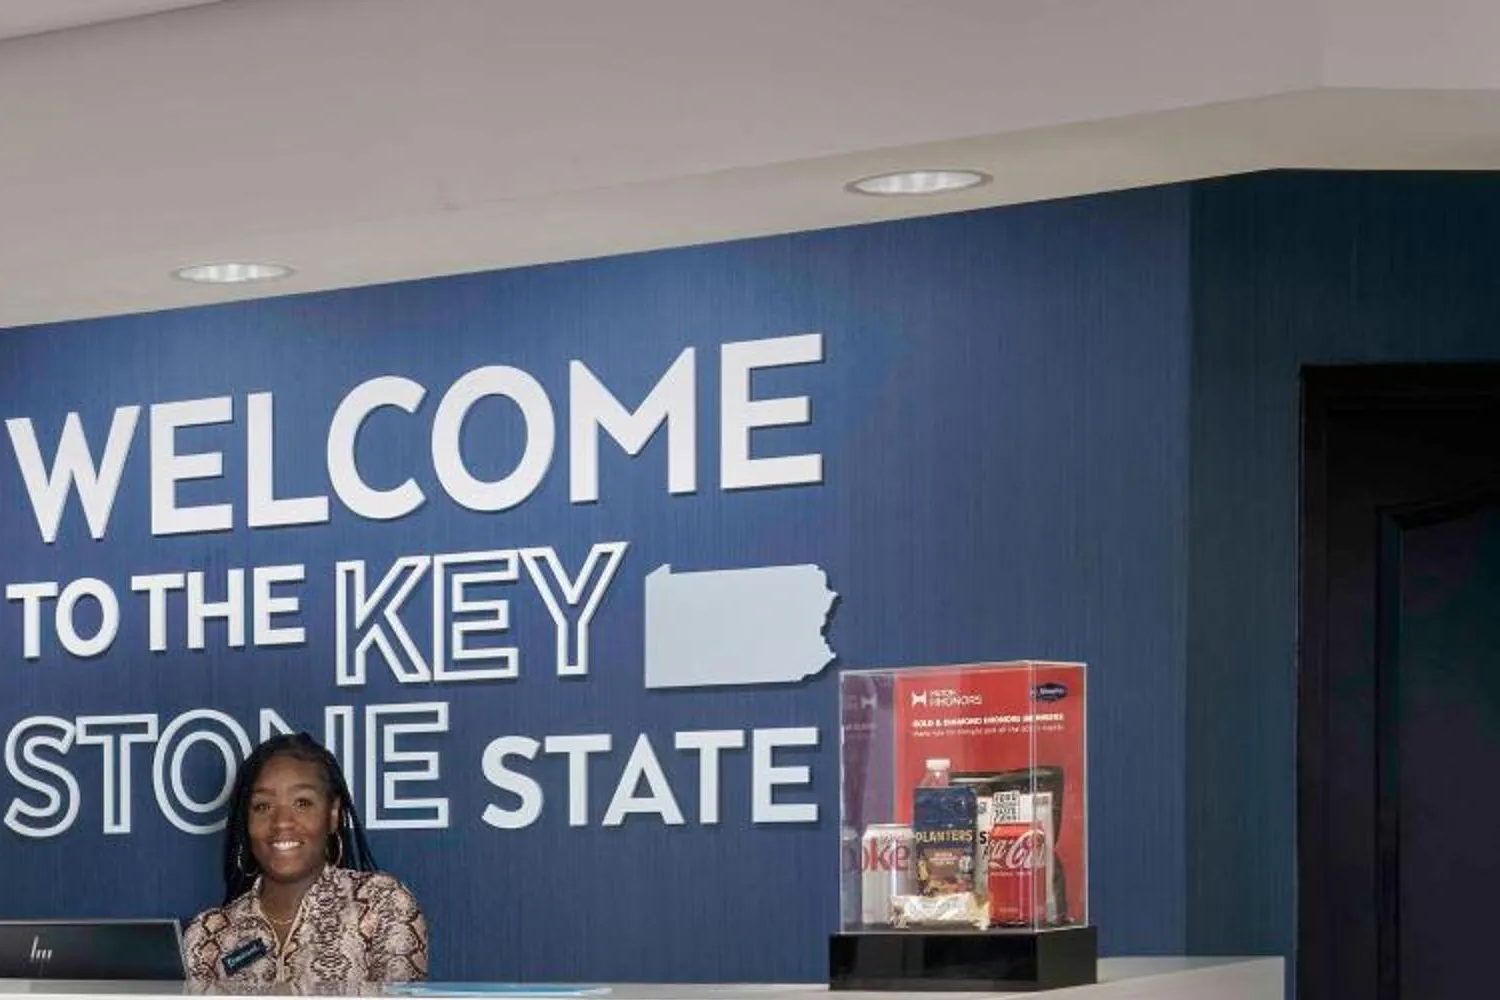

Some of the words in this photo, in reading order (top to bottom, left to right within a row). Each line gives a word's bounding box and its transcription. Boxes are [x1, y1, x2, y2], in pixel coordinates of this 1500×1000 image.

[5, 333, 823, 543] WELCOME
[5, 577, 120, 659] TO
[130, 563, 306, 652] THE
[335, 541, 629, 686] KEY
[481, 726, 820, 829] STATE
[914, 830, 973, 843] PLANTERS
